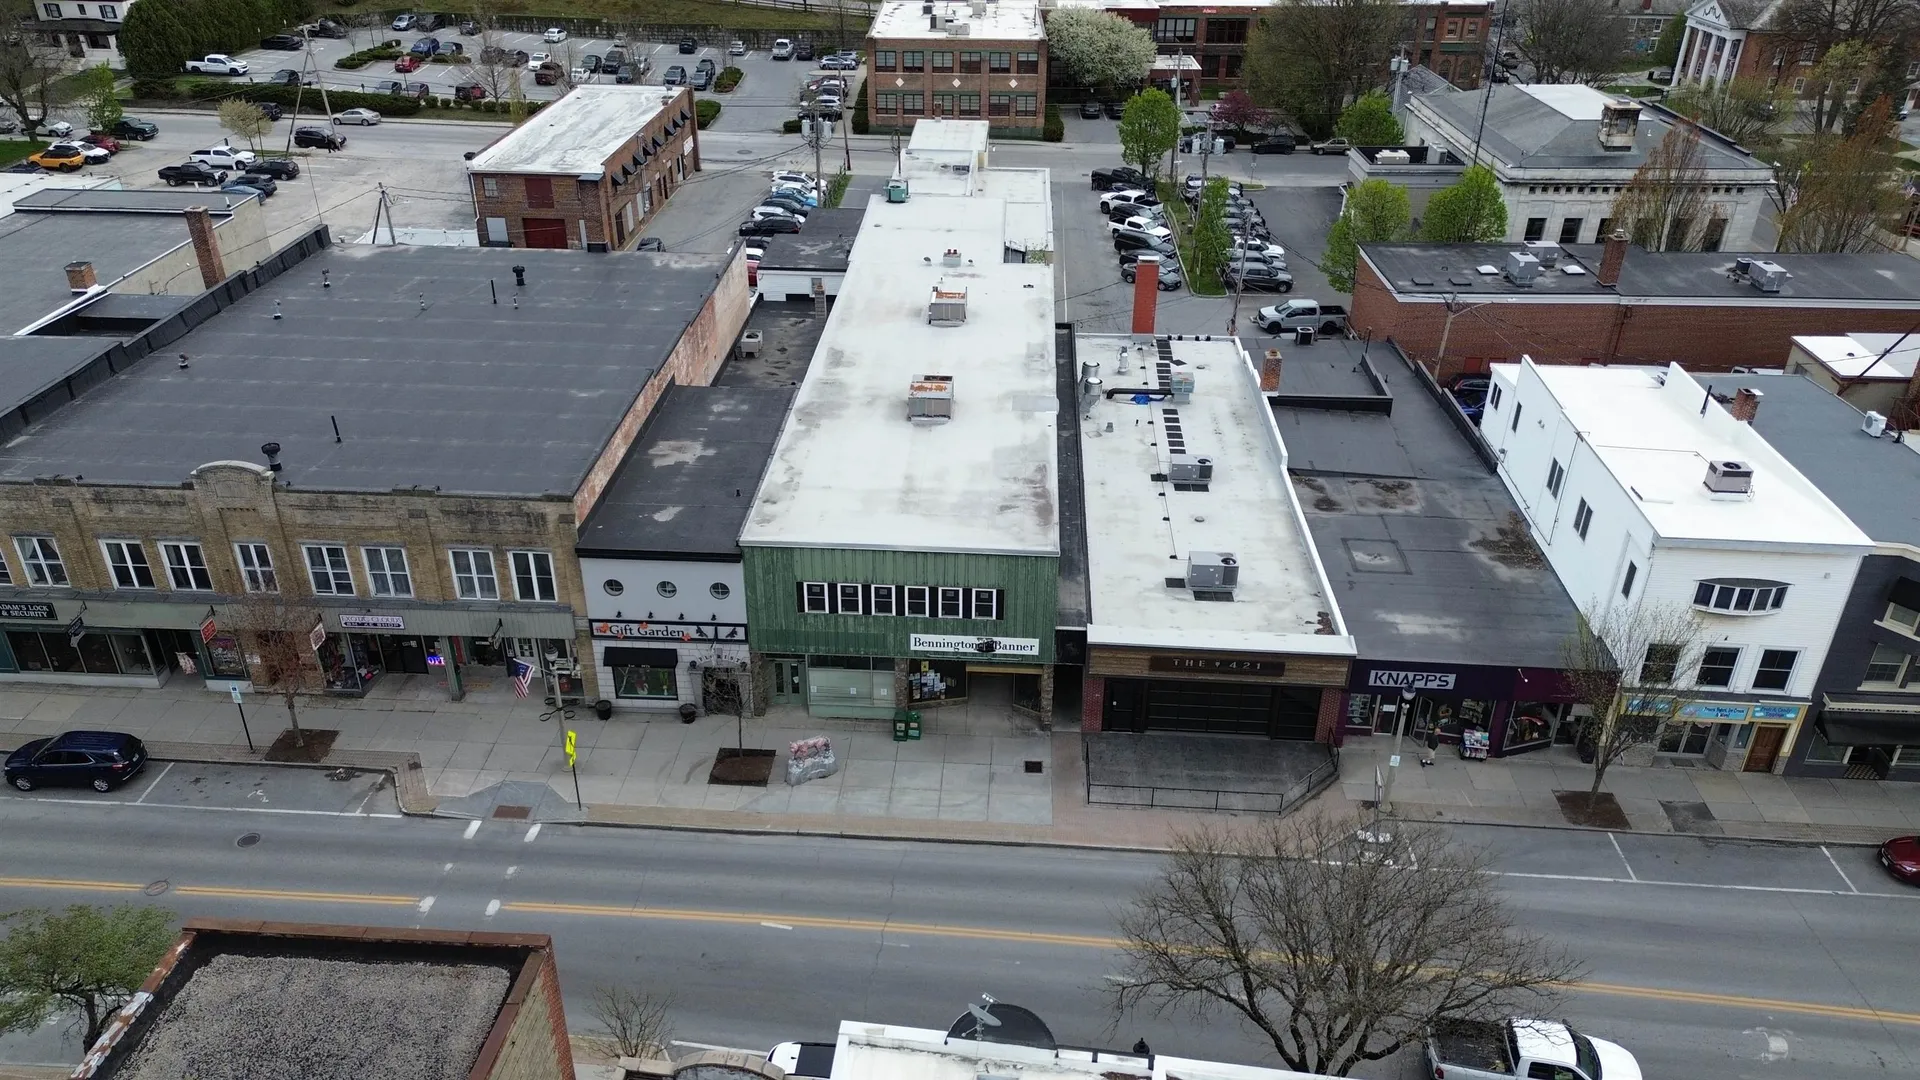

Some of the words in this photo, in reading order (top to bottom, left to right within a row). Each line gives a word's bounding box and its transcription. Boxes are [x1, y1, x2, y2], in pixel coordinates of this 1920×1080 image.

[28, 604, 49, 612] LOCK
[609, 624, 634, 637] Gift
[637, 624, 685, 637] Garden
[913, 636, 978, 651] Bennington
[993, 640, 1035, 652] Banner
[1173, 658, 1205, 667] THE
[1229, 661, 1261, 670] 421
[1373, 671, 1450, 688] KNAPPS
